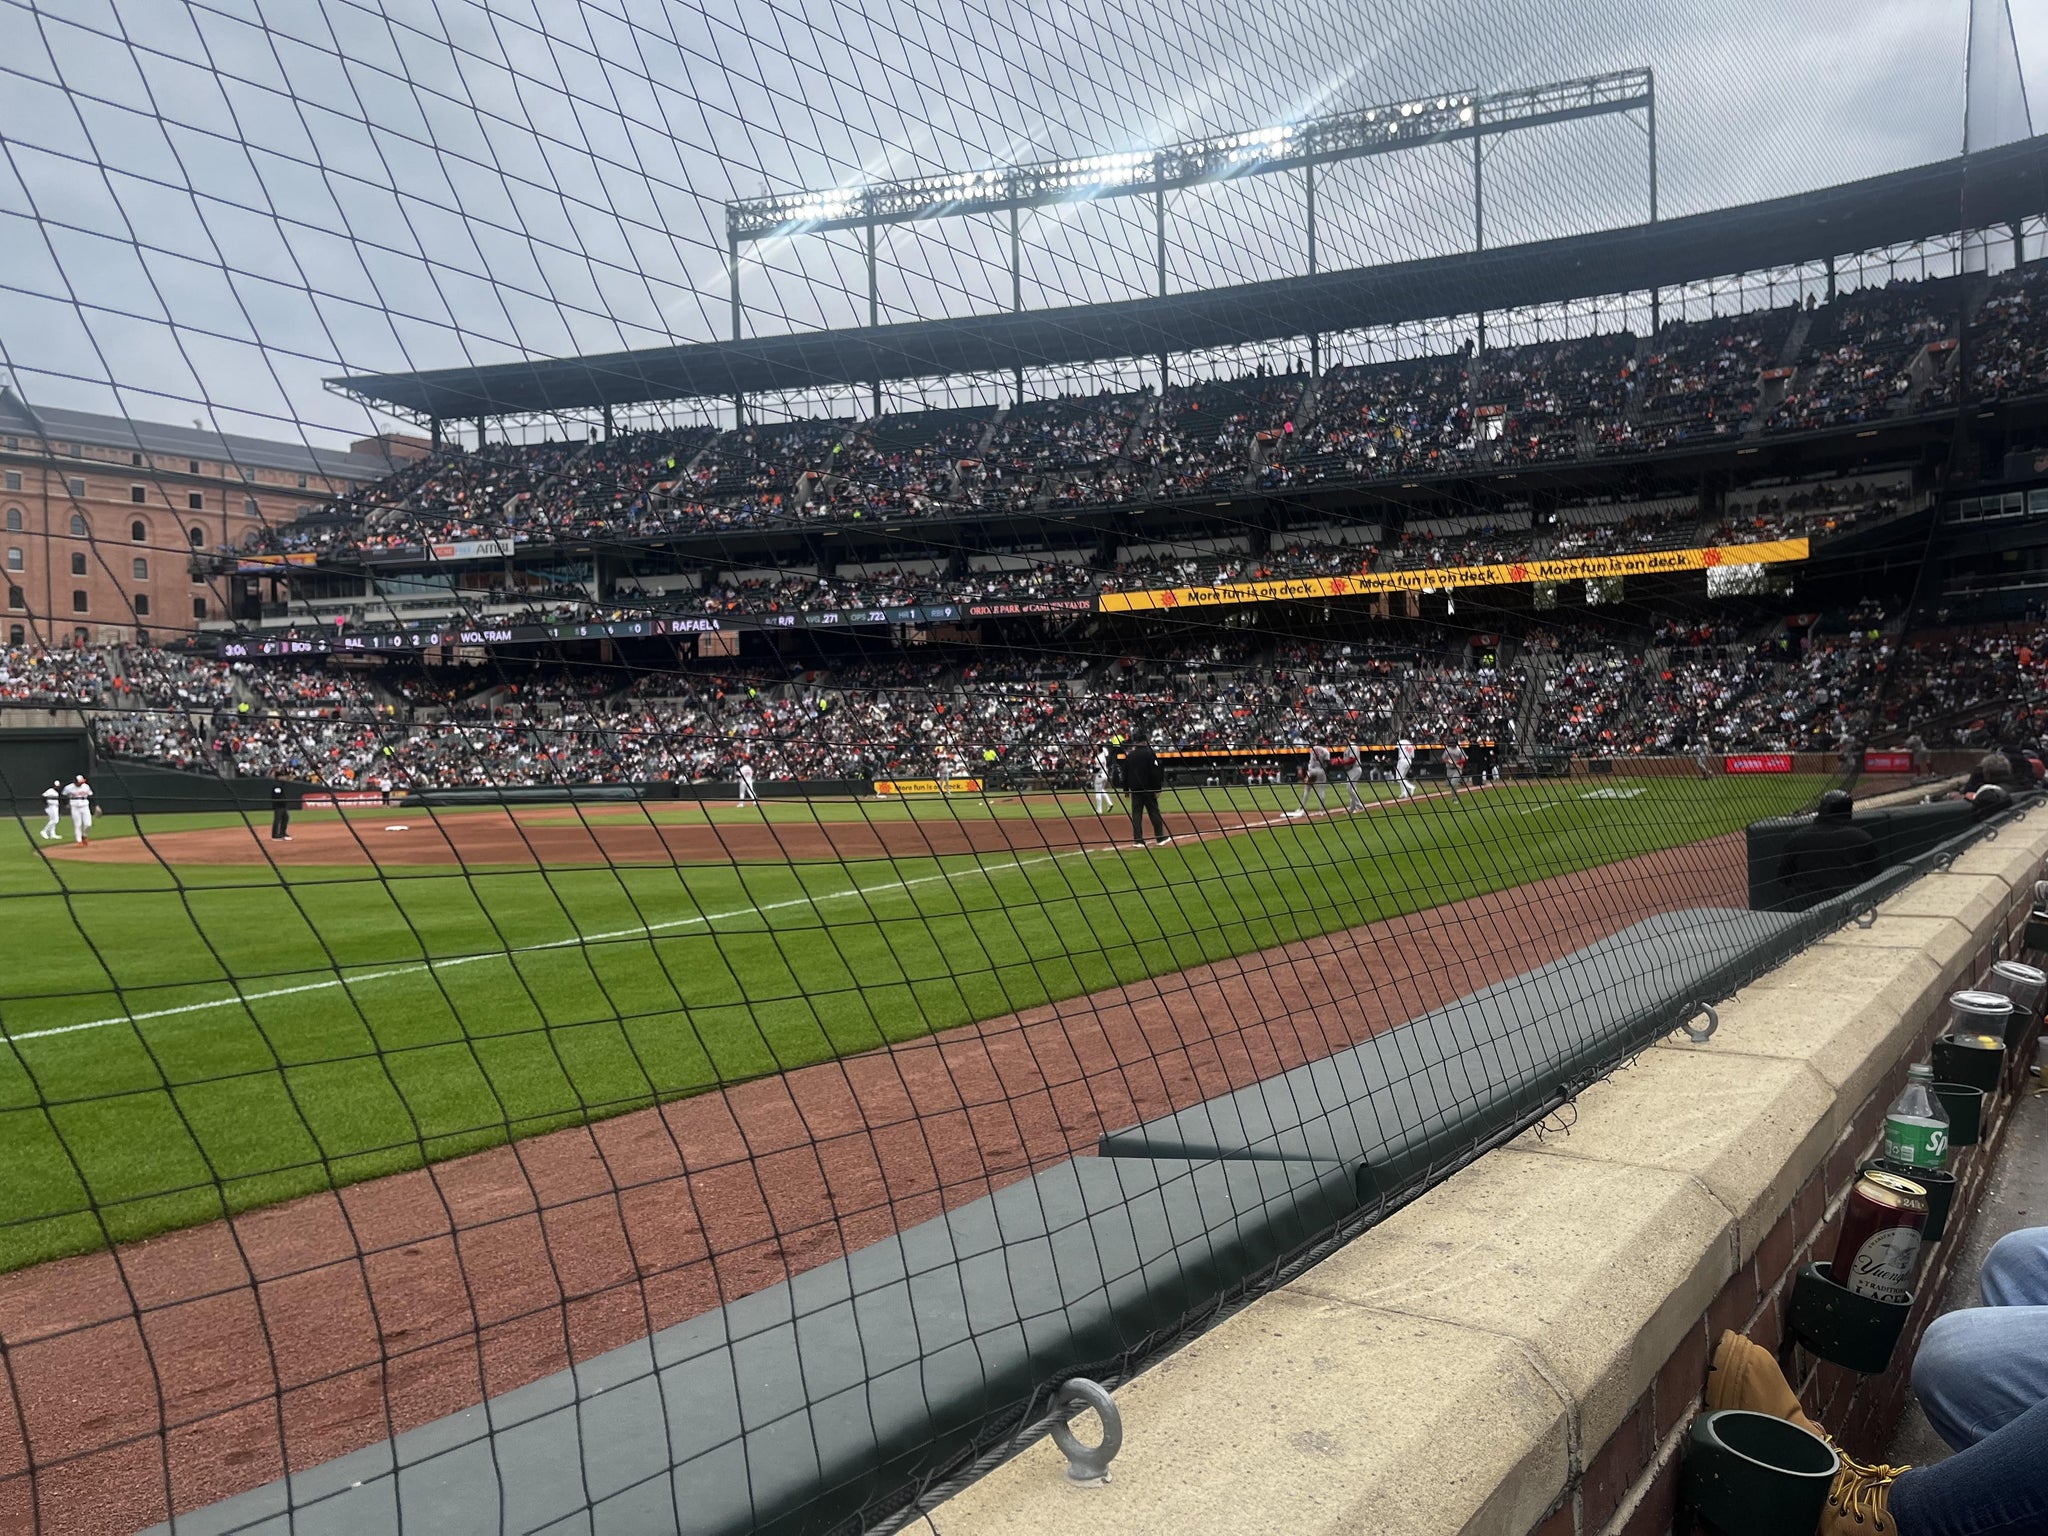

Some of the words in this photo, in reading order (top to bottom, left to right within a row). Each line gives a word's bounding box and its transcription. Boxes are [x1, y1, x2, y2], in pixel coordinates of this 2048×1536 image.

[1540, 563, 1578, 576] More
[1581, 562, 1606, 573] fun
[1610, 560, 1625, 571] is
[1628, 559, 1645, 570] on
[1359, 577, 1394, 589] More
[1400, 575, 1420, 586] fun
[1424, 573, 1435, 584] is
[1439, 574, 1455, 584] on
[1188, 590, 1219, 602] More
[1223, 586, 1246, 600] fun
[1247, 586, 1258, 598] is
[1261, 587, 1276, 597] on
[944, 607, 952, 617] 9
[1000, 604, 1020, 614] PARK
[822, 613, 838, 624] .271
[867, 610, 886, 622] .723
[634, 623, 641, 634] 0
[672, 619, 720, 632] RAFAELA
[373, 637, 379, 648] 1
[394, 635, 402, 647] 0
[412, 634, 420, 646] 2
[430, 633, 439, 645] 0
[461, 630, 512, 643] WOLFRAM
[914, 783, 925, 791] fun
